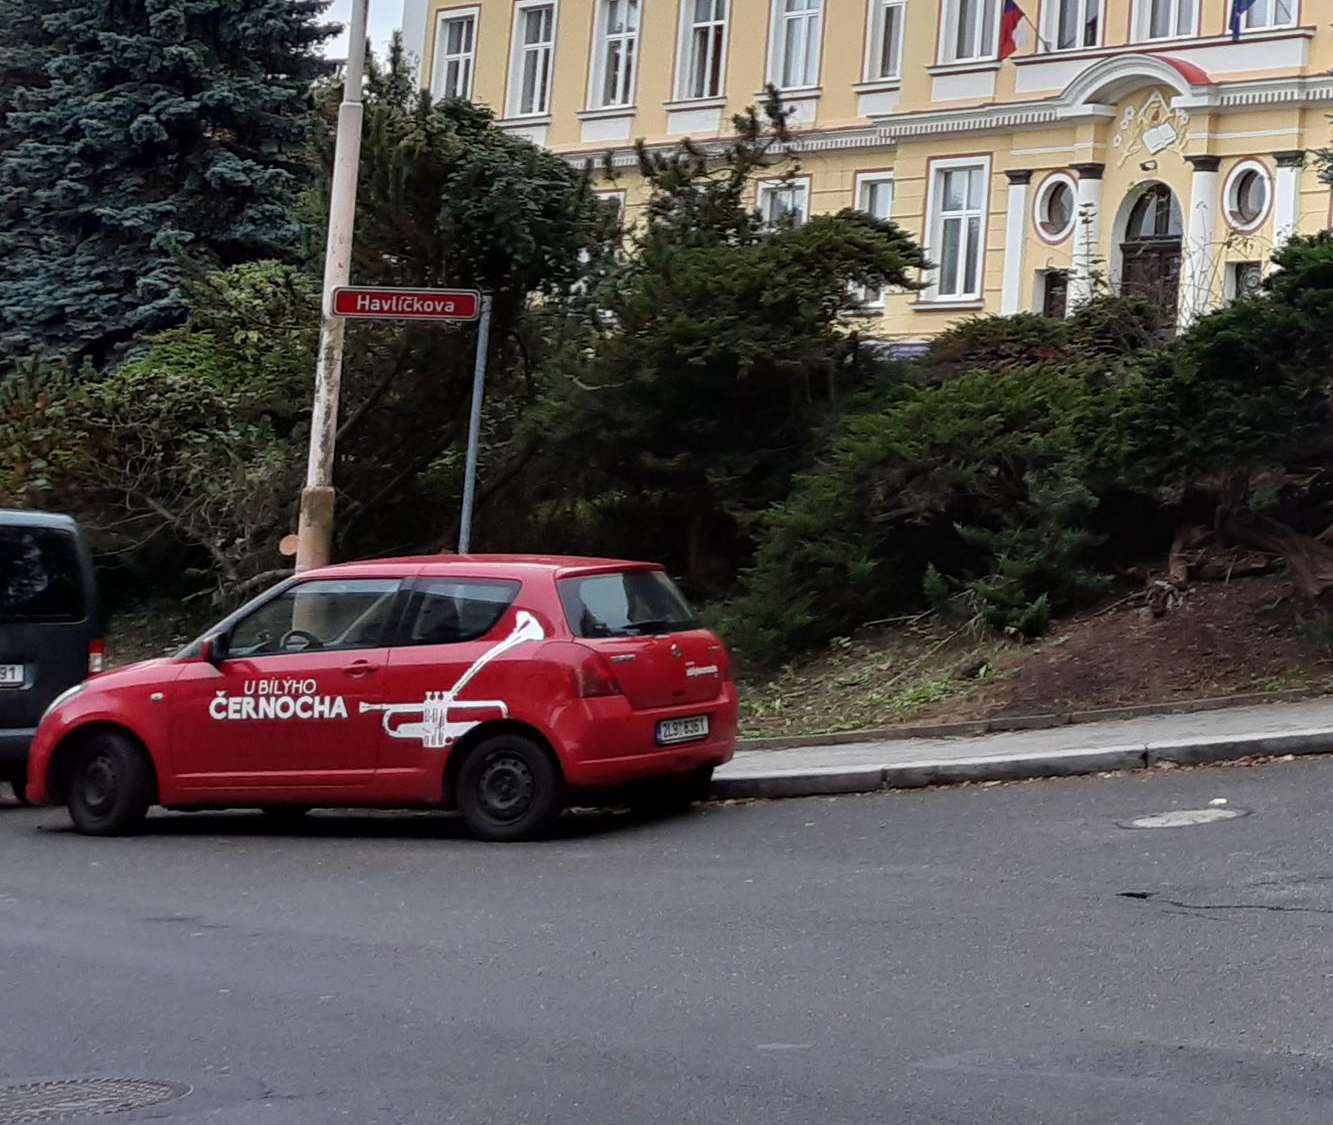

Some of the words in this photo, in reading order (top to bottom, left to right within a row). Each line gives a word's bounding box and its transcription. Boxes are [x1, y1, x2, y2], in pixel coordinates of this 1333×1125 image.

[356, 295, 455, 313] Havlíčkova
[244, 680, 256, 695] U
[209, 690, 348, 719] ČERNOCHA
